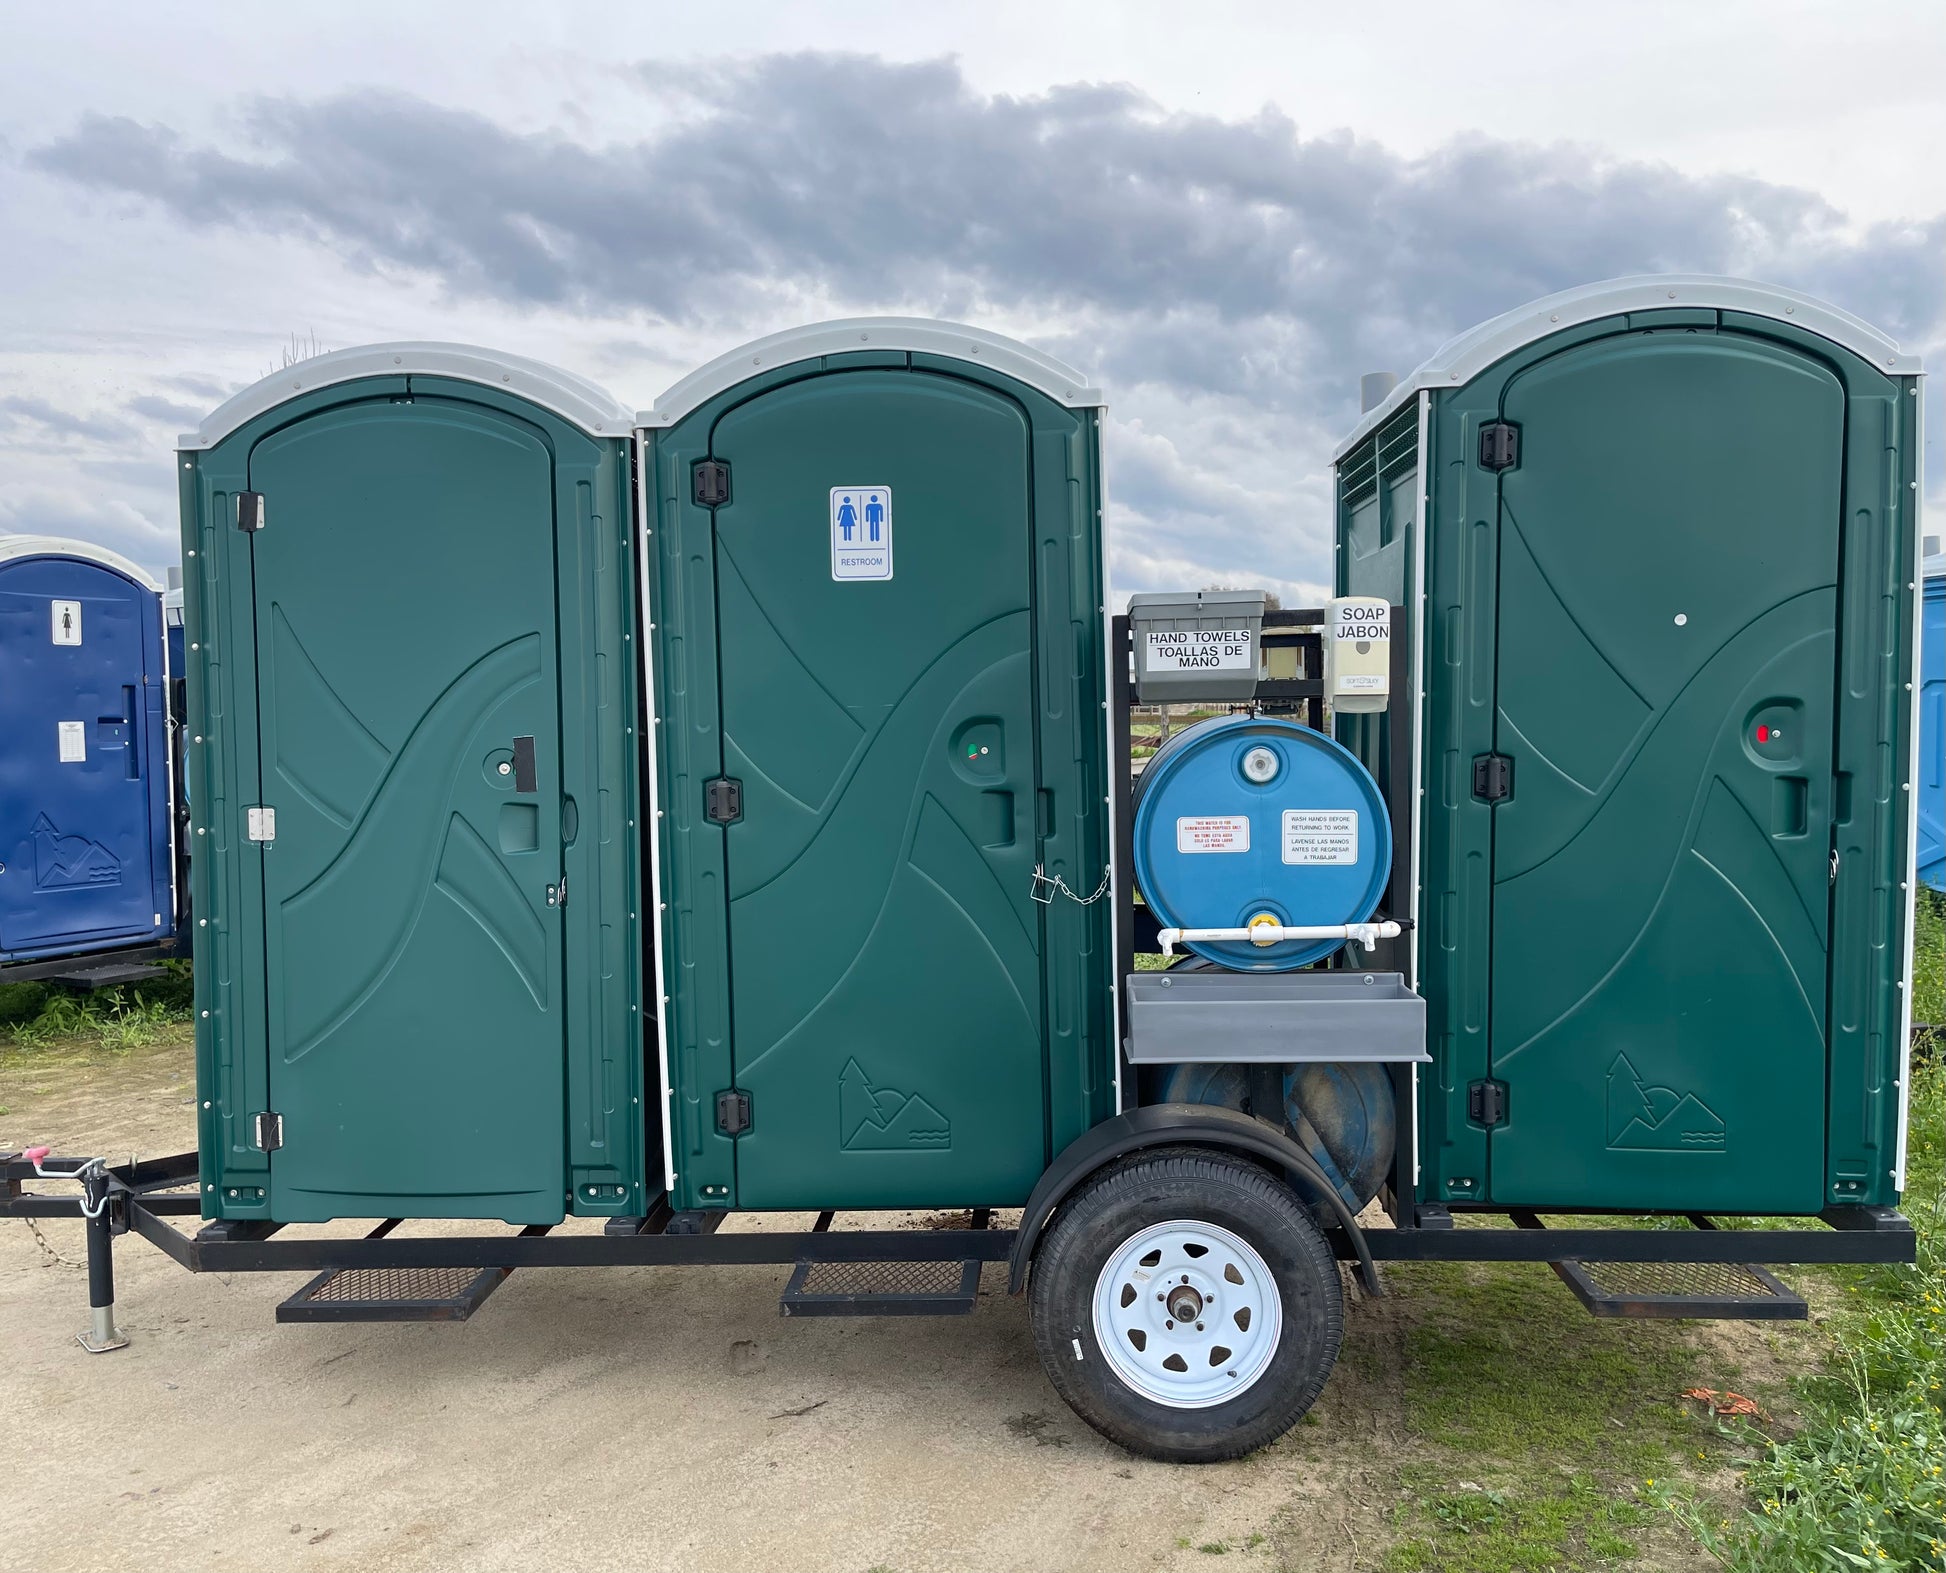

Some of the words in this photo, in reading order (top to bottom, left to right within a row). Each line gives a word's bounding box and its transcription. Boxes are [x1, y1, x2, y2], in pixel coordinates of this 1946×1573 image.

[841, 558, 882, 566] RESTROOM
[1342, 607, 1385, 620] SOAP
[1150, 633, 1187, 644] HAND
[1193, 631, 1250, 643] TOWELS
[1337, 625, 1389, 638] JABON
[1157, 646, 1218, 657] TOALLAS
[1224, 645, 1242, 656] DE
[1179, 656, 1220, 667] MANO
